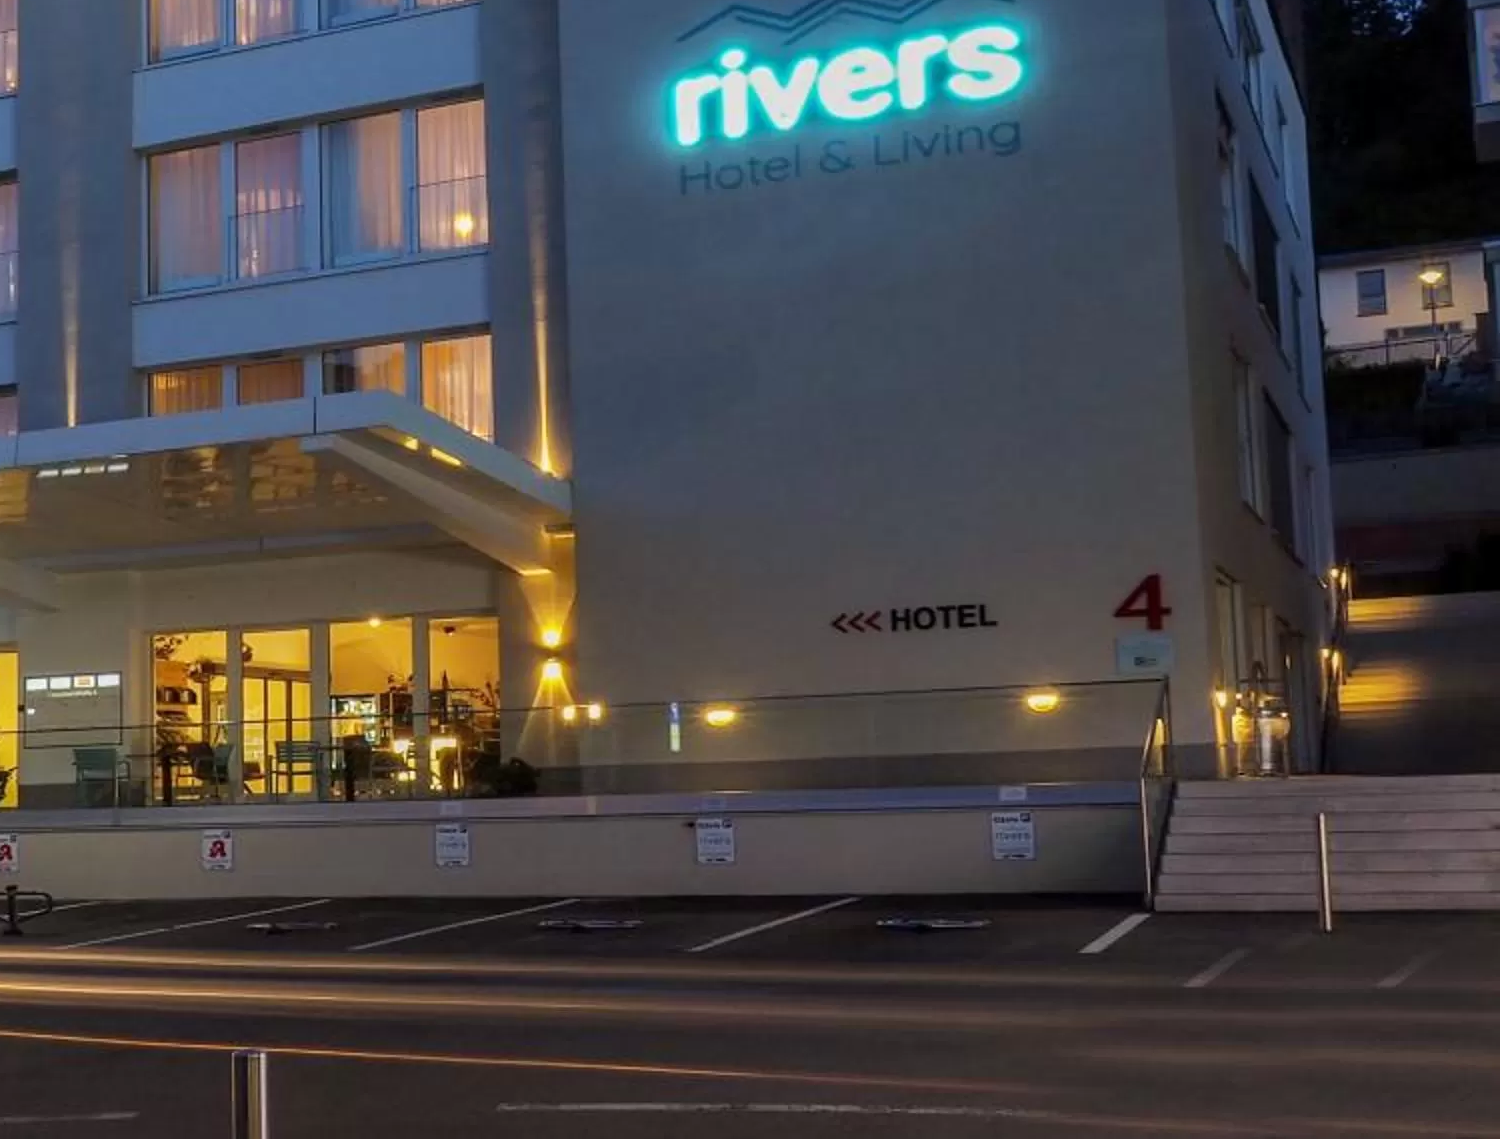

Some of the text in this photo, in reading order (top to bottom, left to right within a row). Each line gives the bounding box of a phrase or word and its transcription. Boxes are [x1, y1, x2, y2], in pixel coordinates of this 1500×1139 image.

[674, 25, 1023, 146] rivers
[678, 119, 1022, 196] Hotel & Living
[889, 604, 998, 632] HOTEL
[1113, 572, 1172, 631] 4
